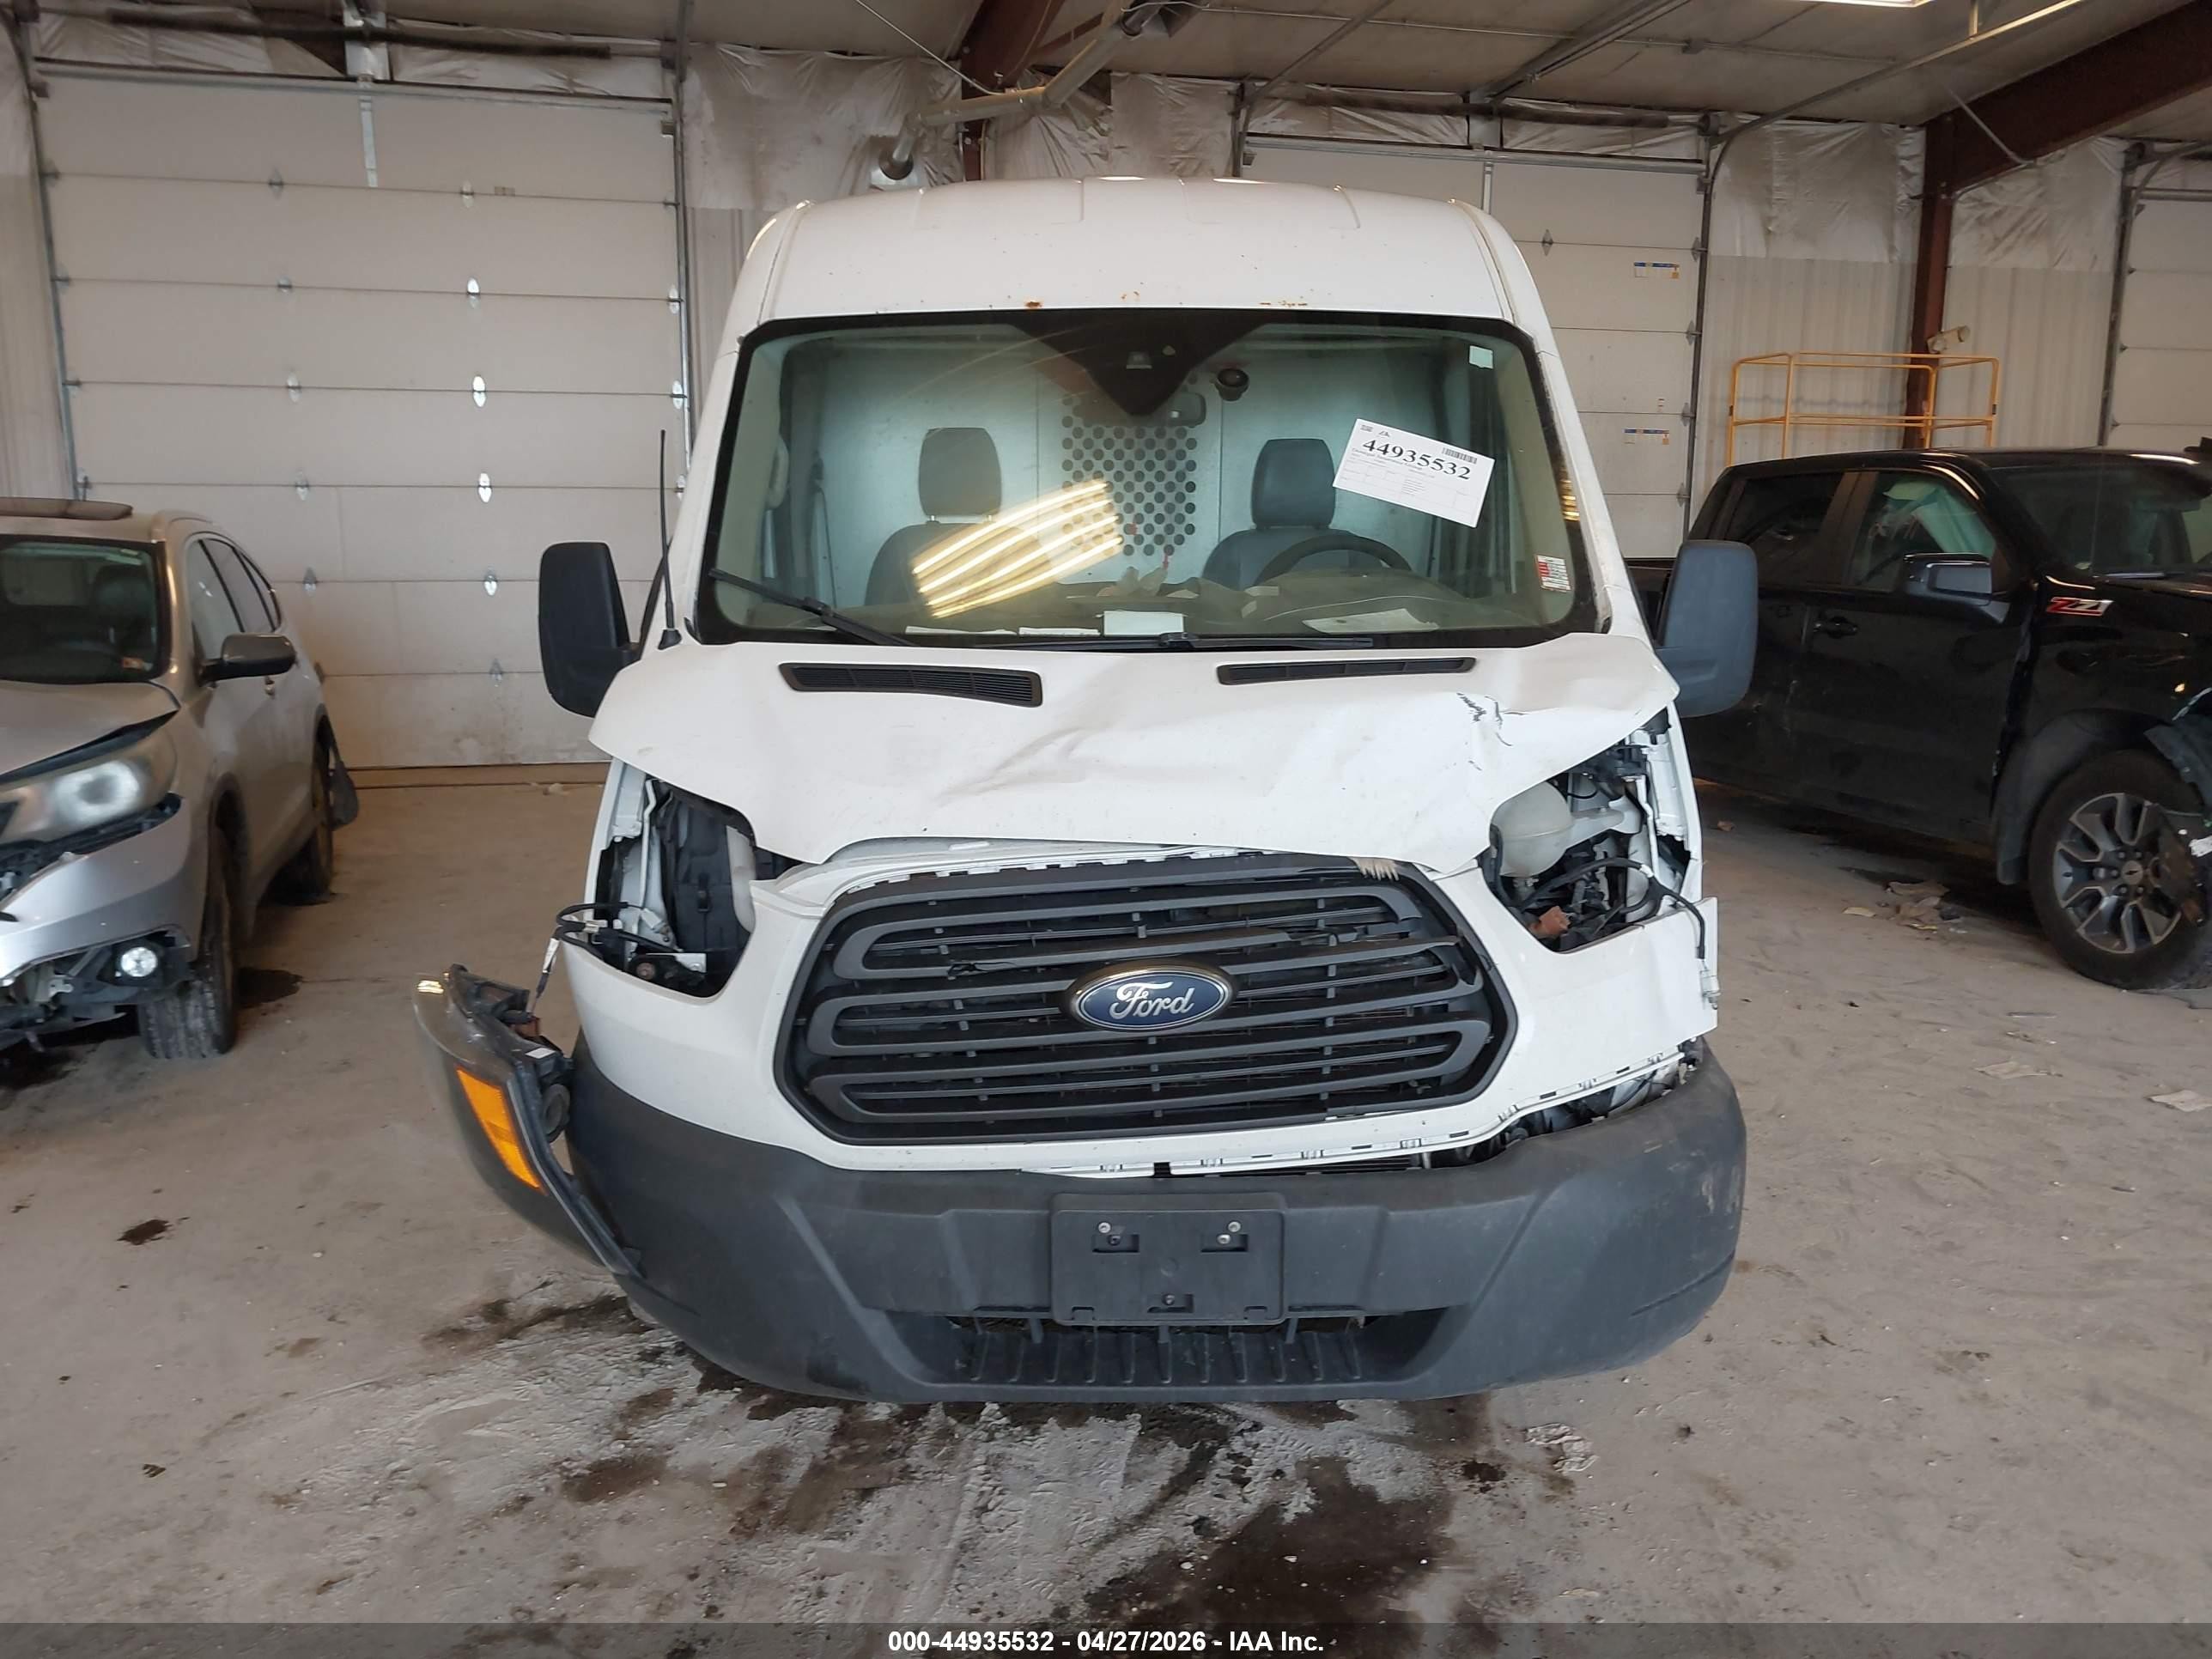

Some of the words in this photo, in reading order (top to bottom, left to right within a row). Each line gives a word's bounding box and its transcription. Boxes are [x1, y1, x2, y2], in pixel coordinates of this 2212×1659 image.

[1363, 439, 1471, 480] 44935532
[2046, 597, 2113, 617] Z71
[1109, 981, 1194, 1019] Ford
